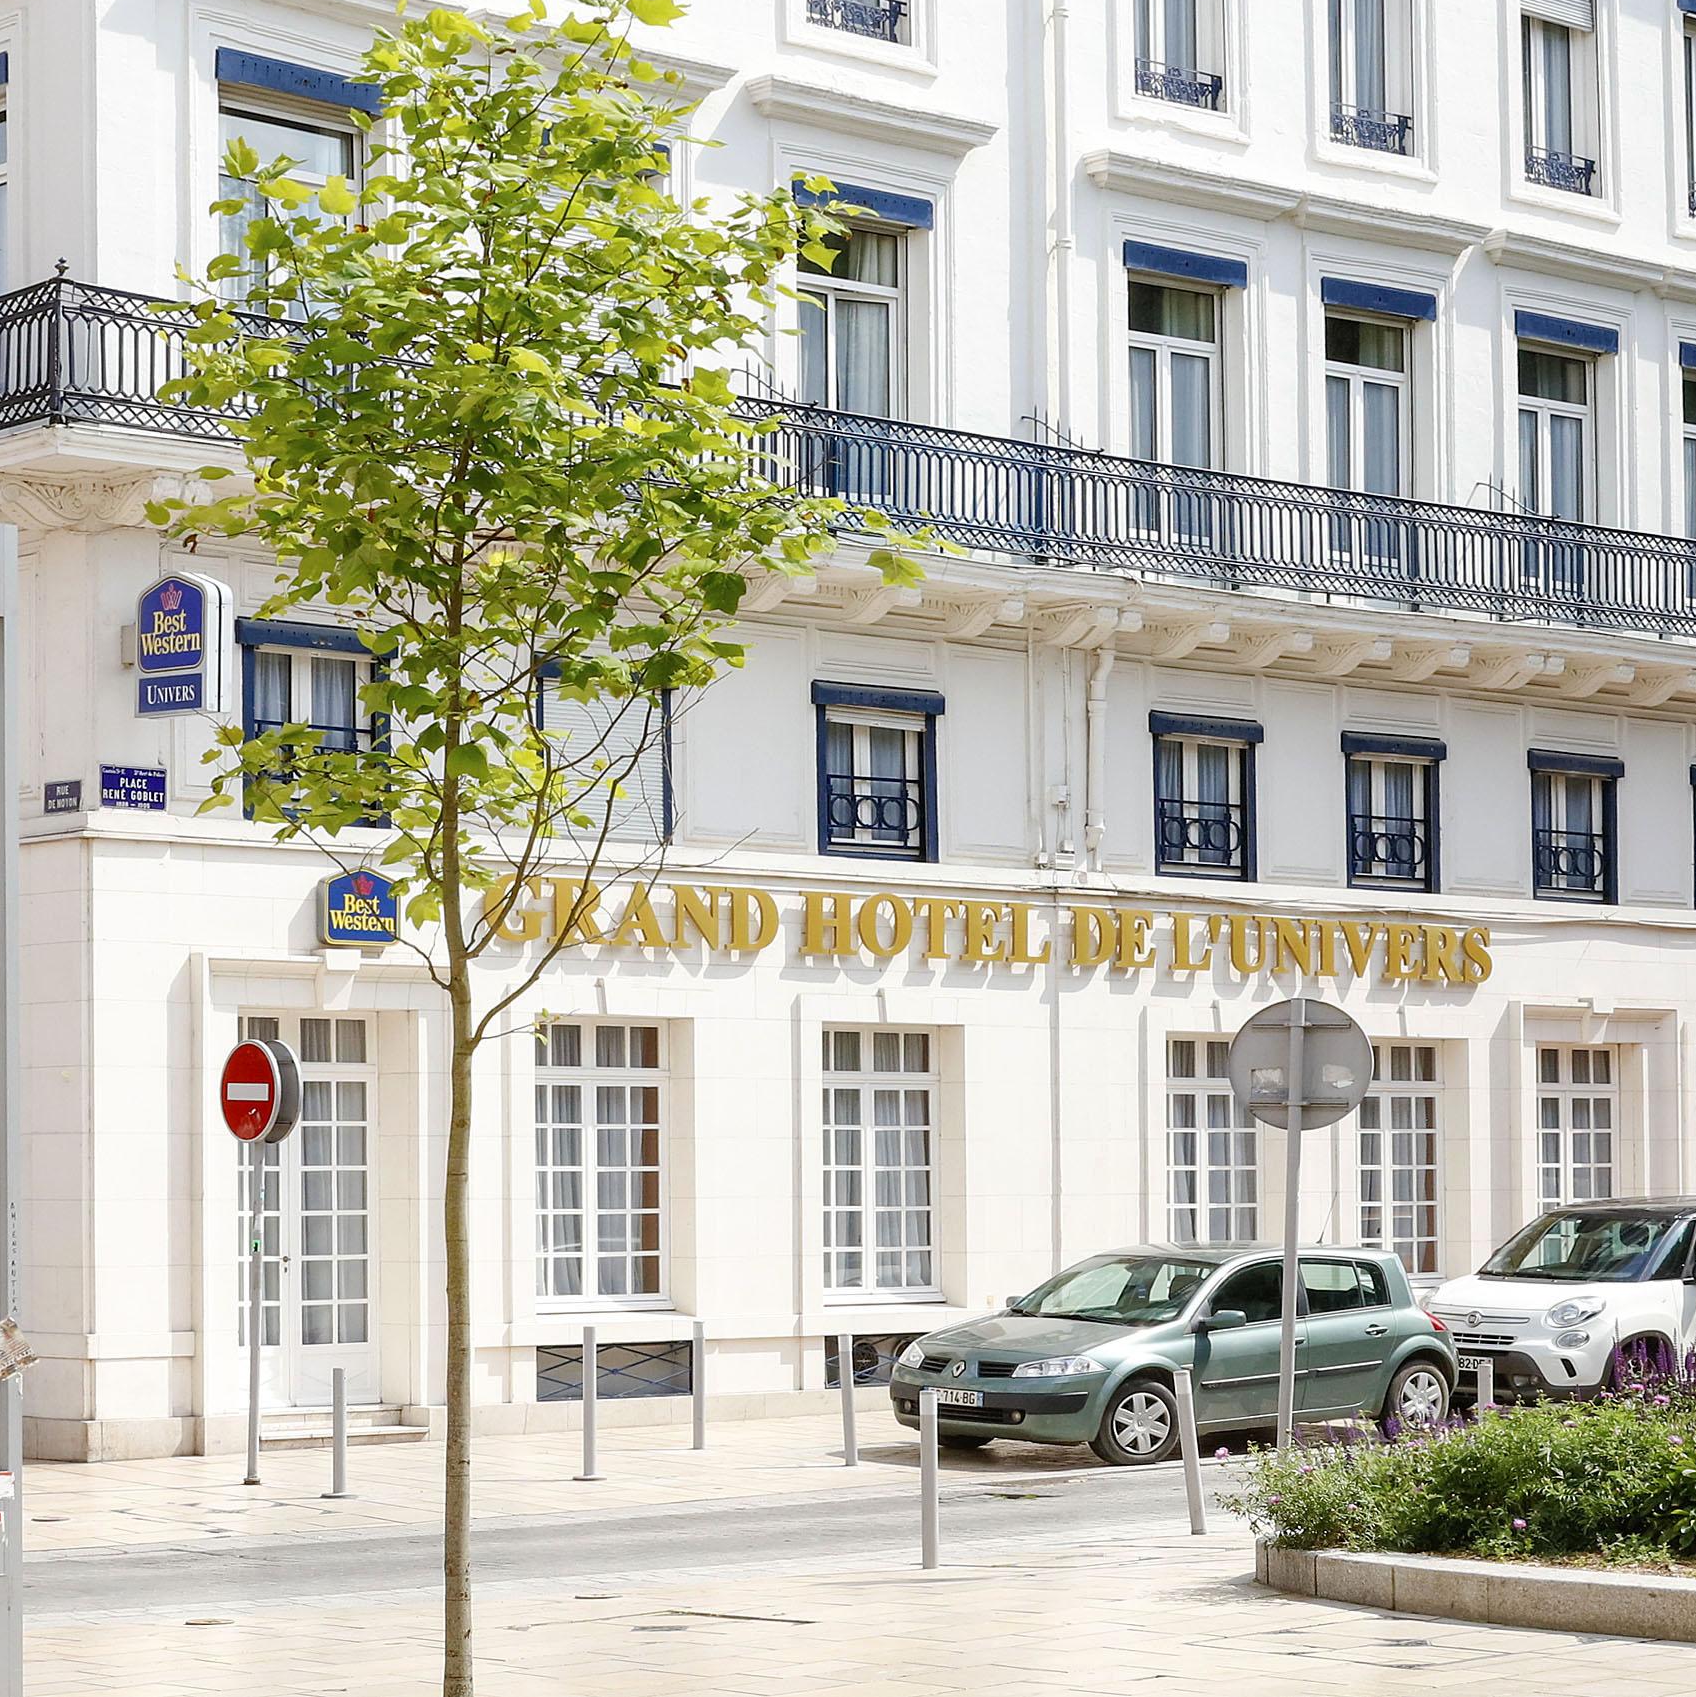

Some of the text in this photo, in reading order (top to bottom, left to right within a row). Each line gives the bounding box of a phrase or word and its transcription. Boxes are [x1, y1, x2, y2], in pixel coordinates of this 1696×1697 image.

[153, 609, 187, 635] Best
[141, 632, 202, 656] Western
[56, 785, 69, 796] RUE
[120, 777, 148, 789] PLACE
[103, 788, 165, 802] RENÉ GOBLET
[344, 893, 380, 915] Best
[330, 910, 395, 932] Western
[483, 872, 1492, 983] GRAND HOTEL DE L'UNIVERS
